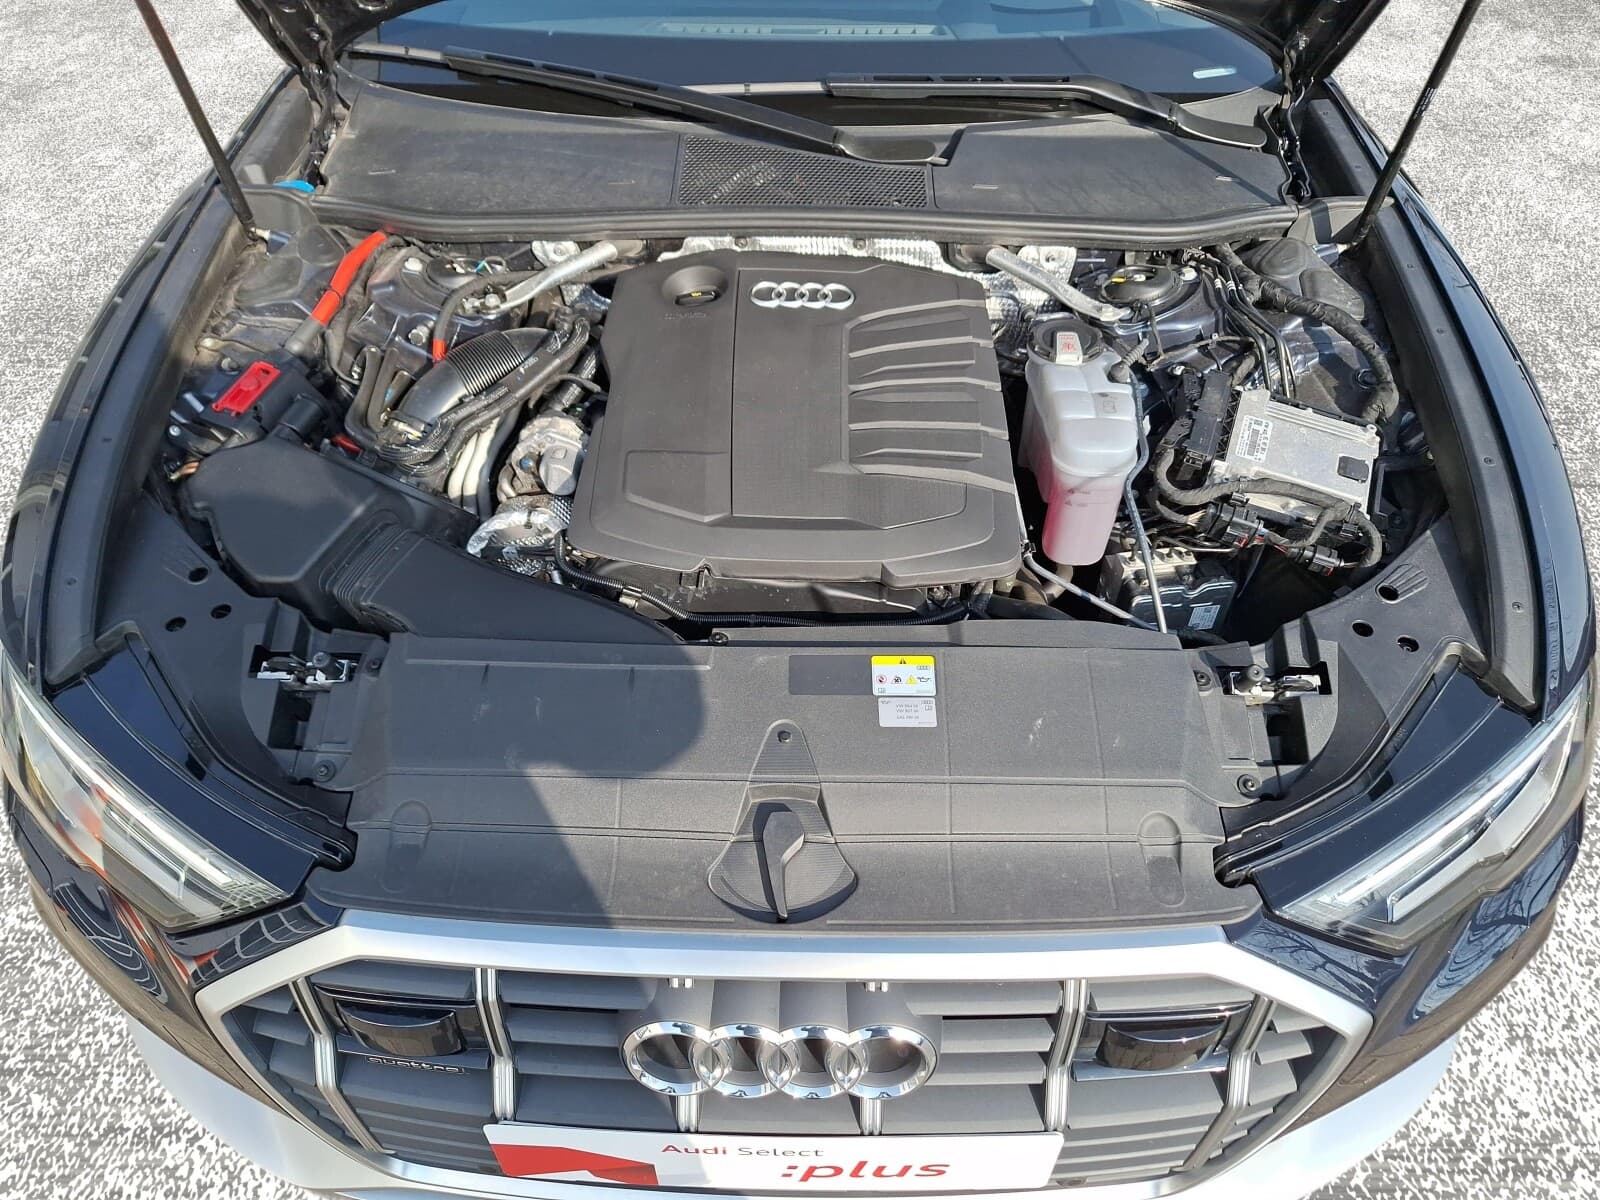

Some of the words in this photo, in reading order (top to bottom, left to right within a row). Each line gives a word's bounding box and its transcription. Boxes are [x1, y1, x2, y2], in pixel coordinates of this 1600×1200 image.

[367, 1057, 460, 1072] quattro
[661, 1144, 727, 1155] Audi
[738, 1147, 824, 1157] Select
